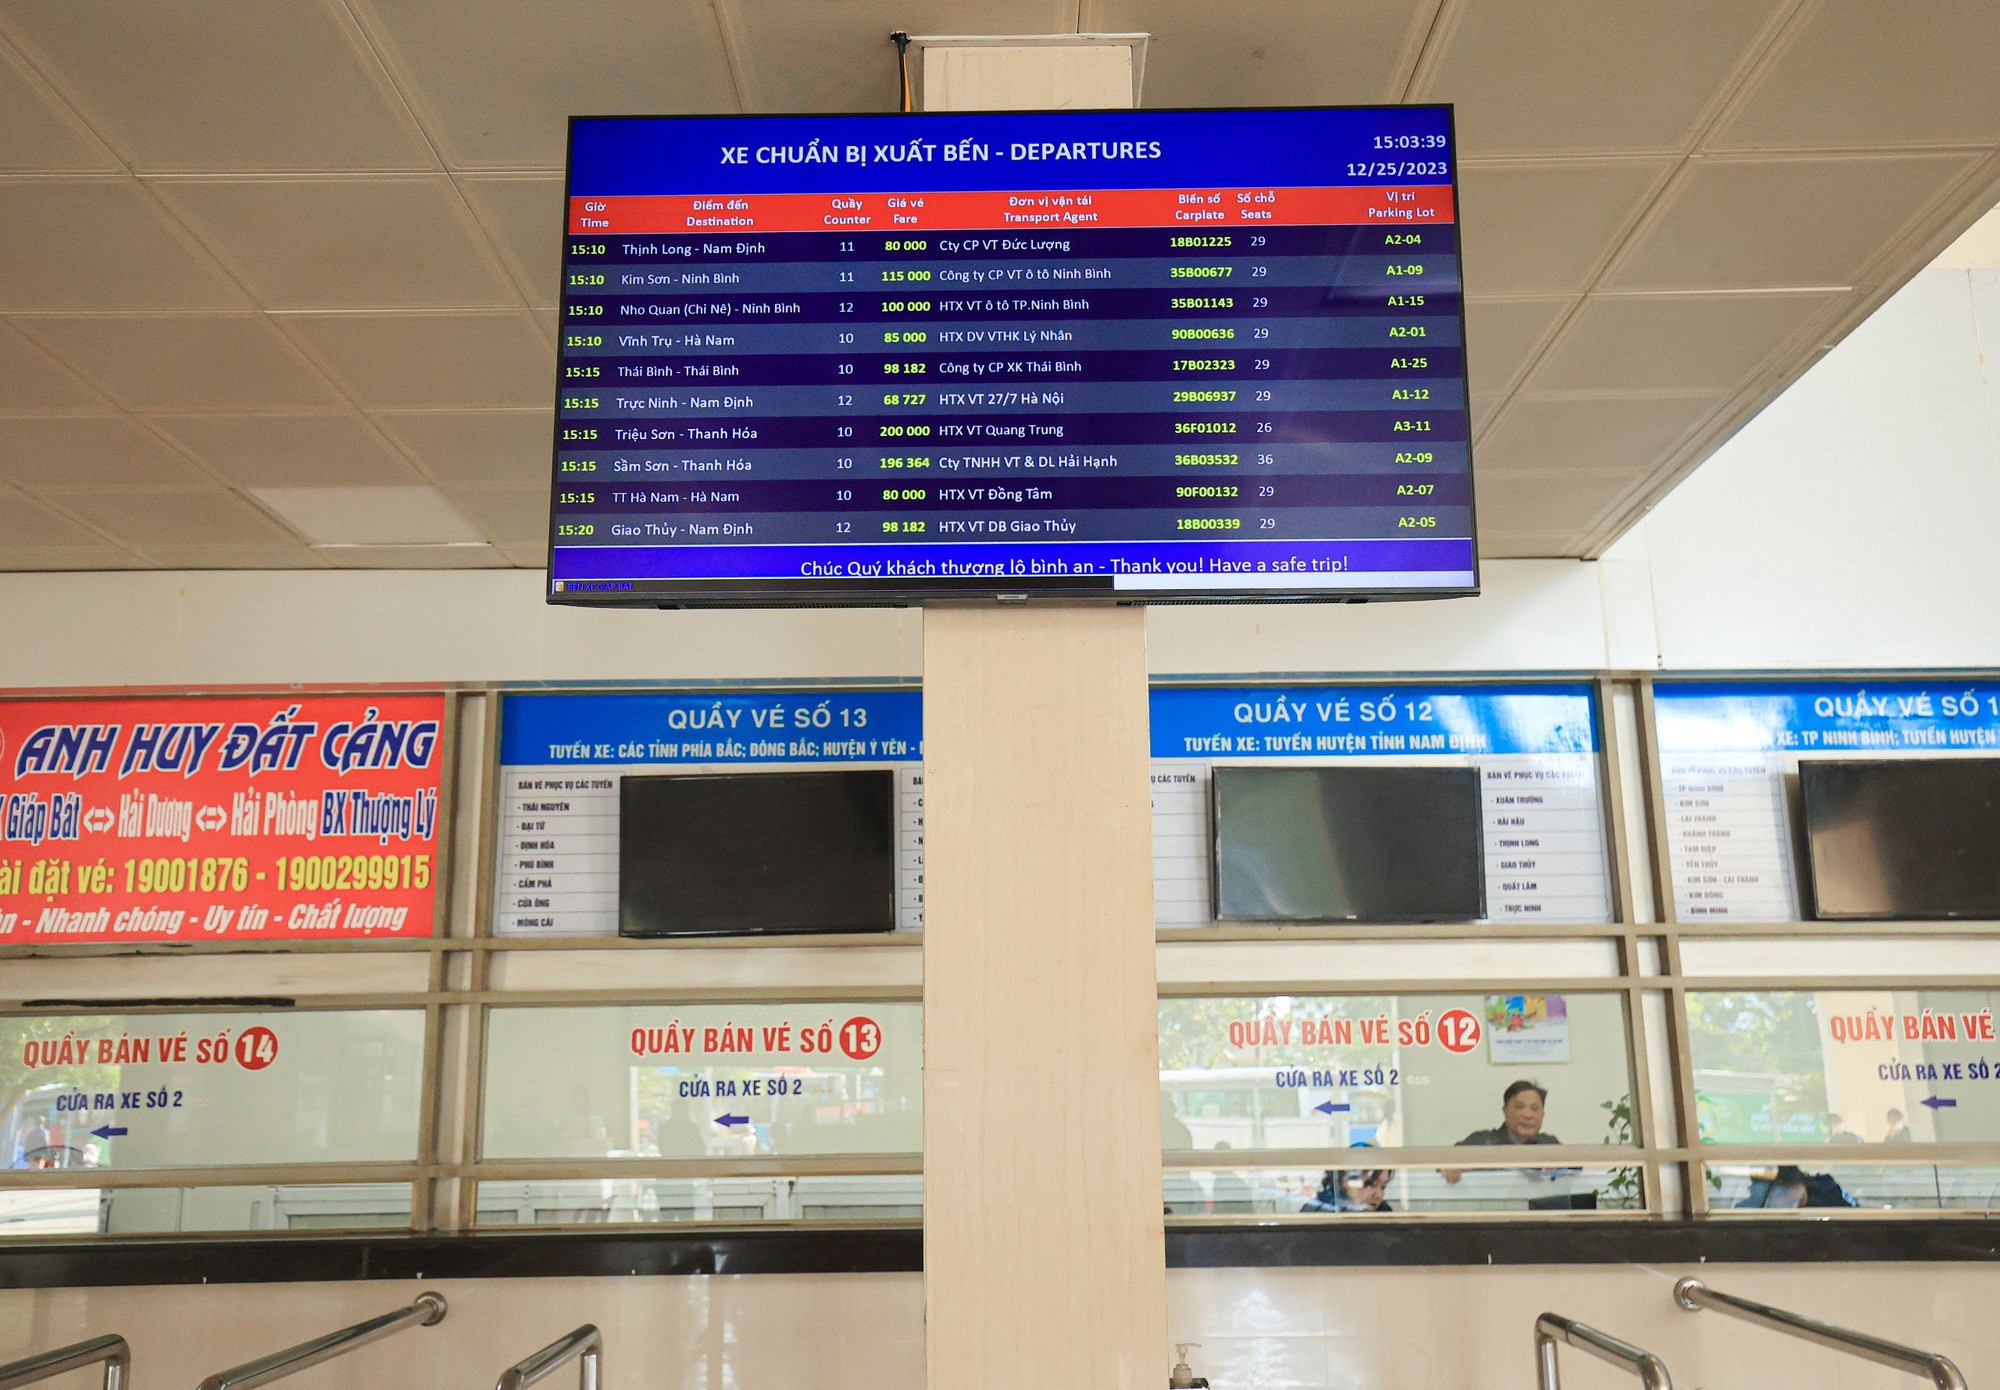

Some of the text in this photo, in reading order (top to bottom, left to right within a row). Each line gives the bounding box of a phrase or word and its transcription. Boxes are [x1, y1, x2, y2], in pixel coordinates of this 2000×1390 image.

[1374, 135, 1446, 149] 15:03:39
[720, 137, 1161, 166] XE CHUẨN BỊ XUẤT BẾN DEPARTURES
[1347, 162, 1447, 177] 12/25/2023
[887, 198, 924, 208] Giá vé
[1009, 195, 1092, 208] Đơn vị vận tải
[1178, 192, 1221, 204] Biển số
[1237, 190, 1275, 203] Số chỗ
[1386, 191, 1415, 203] Vị trí
[585, 202, 607, 212] Giờ
[693, 199, 749, 210] Điểm đến
[832, 197, 863, 211] Quầy
[824, 215, 871, 225] Counter
[894, 214, 918, 224] Fare
[1003, 212, 1098, 224] Transport Agent
[1175, 209, 1225, 222] Carplate
[1241, 209, 1272, 219] Seats
[1368, 207, 1435, 220] Parking Lot
[580, 218, 609, 228] Time
[687, 216, 754, 226] Destination
[885, 240, 927, 251] 80 000
[939, 238, 1070, 253] Cty CP VT Đức Lượng
[1170, 236, 1232, 247] 18B01225
[1251, 236, 1266, 246] 29
[1385, 234, 1422, 245] A2-04
[571, 244, 606, 255] 15:10
[622, 242, 765, 257] Thịnh Long Nam Định
[840, 241, 854, 252] 11
[836, 522, 851, 533] 12
[882, 521, 925, 533] 98 182
[939, 518, 1076, 534] HTX VT DB Giao Thủy
[1177, 518, 1241, 530] 18B00339
[1260, 518, 1275, 529] 29
[1398, 517, 1436, 528] A2-05
[558, 525, 594, 535] 15:20
[611, 522, 753, 538] Giao Thủy Nam Định
[801, 560, 842, 574] Chúc
[847, 560, 882, 574] Quý
[887, 559, 935, 574] khách
[1031, 558, 1068, 572] bình
[1073, 563, 1093, 572] an
[1110, 557, 1161, 572] Thank
[1166, 557, 1203, 571] you!
[1210, 558, 1252, 571] Have
[1257, 561, 1266, 570] a
[1272, 556, 1307, 570] safe
[1311, 555, 1348, 570] trip!
[1234, 694, 1433, 723] QUẦY VÉ SỐ 12
[1814, 687, 1980, 719] QUẦY VÉ SỐ
[668, 700, 867, 730] QUẦY VÉ SỐ 13
[14, 704, 440, 781] ANH HUY ĐẤT CẢNG
[549, 740, 590, 759] TUYẾN
[594, 744, 614, 758] XE:
[618, 741, 645, 758] CÁC
[648, 739, 678, 758] TỈNH
[682, 740, 712, 757] PHÍA
[716, 737, 746, 758] BẮC;
[750, 739, 786, 757] ĐÔNG
[789, 737, 819, 757] BẮC;
[823, 738, 866, 759] HUYỆN
[870, 738, 877, 755] Ý
[881, 738, 906, 755] YÊN
[1184, 733, 1232, 752] TUYẾN
[1236, 737, 1260, 751] XE:
[1264, 732, 1312, 751] TUYẾN
[1316, 733, 1366, 753] HUYỆN
[1370, 731, 1405, 750] TỈNH
[1409, 734, 1445, 749] NAM
[6, 791, 49, 846] Giáp
[47, 791, 83, 841] Bát
[117, 787, 194, 843] Hải Dương
[230, 786, 319, 841] Hải Phòng
[319, 786, 438, 847] BX Thượng Lý
[27, 854, 431, 903] đặt vé: 19001876 1900299915
[34, 901, 409, 936] Nhanh chóng Uy tín Chất lượng
[630, 1018, 882, 1057] QUẦY BÁN VÉ SỐ 13
[678, 1072, 802, 1098] CỬA RA XE SỐ 2
